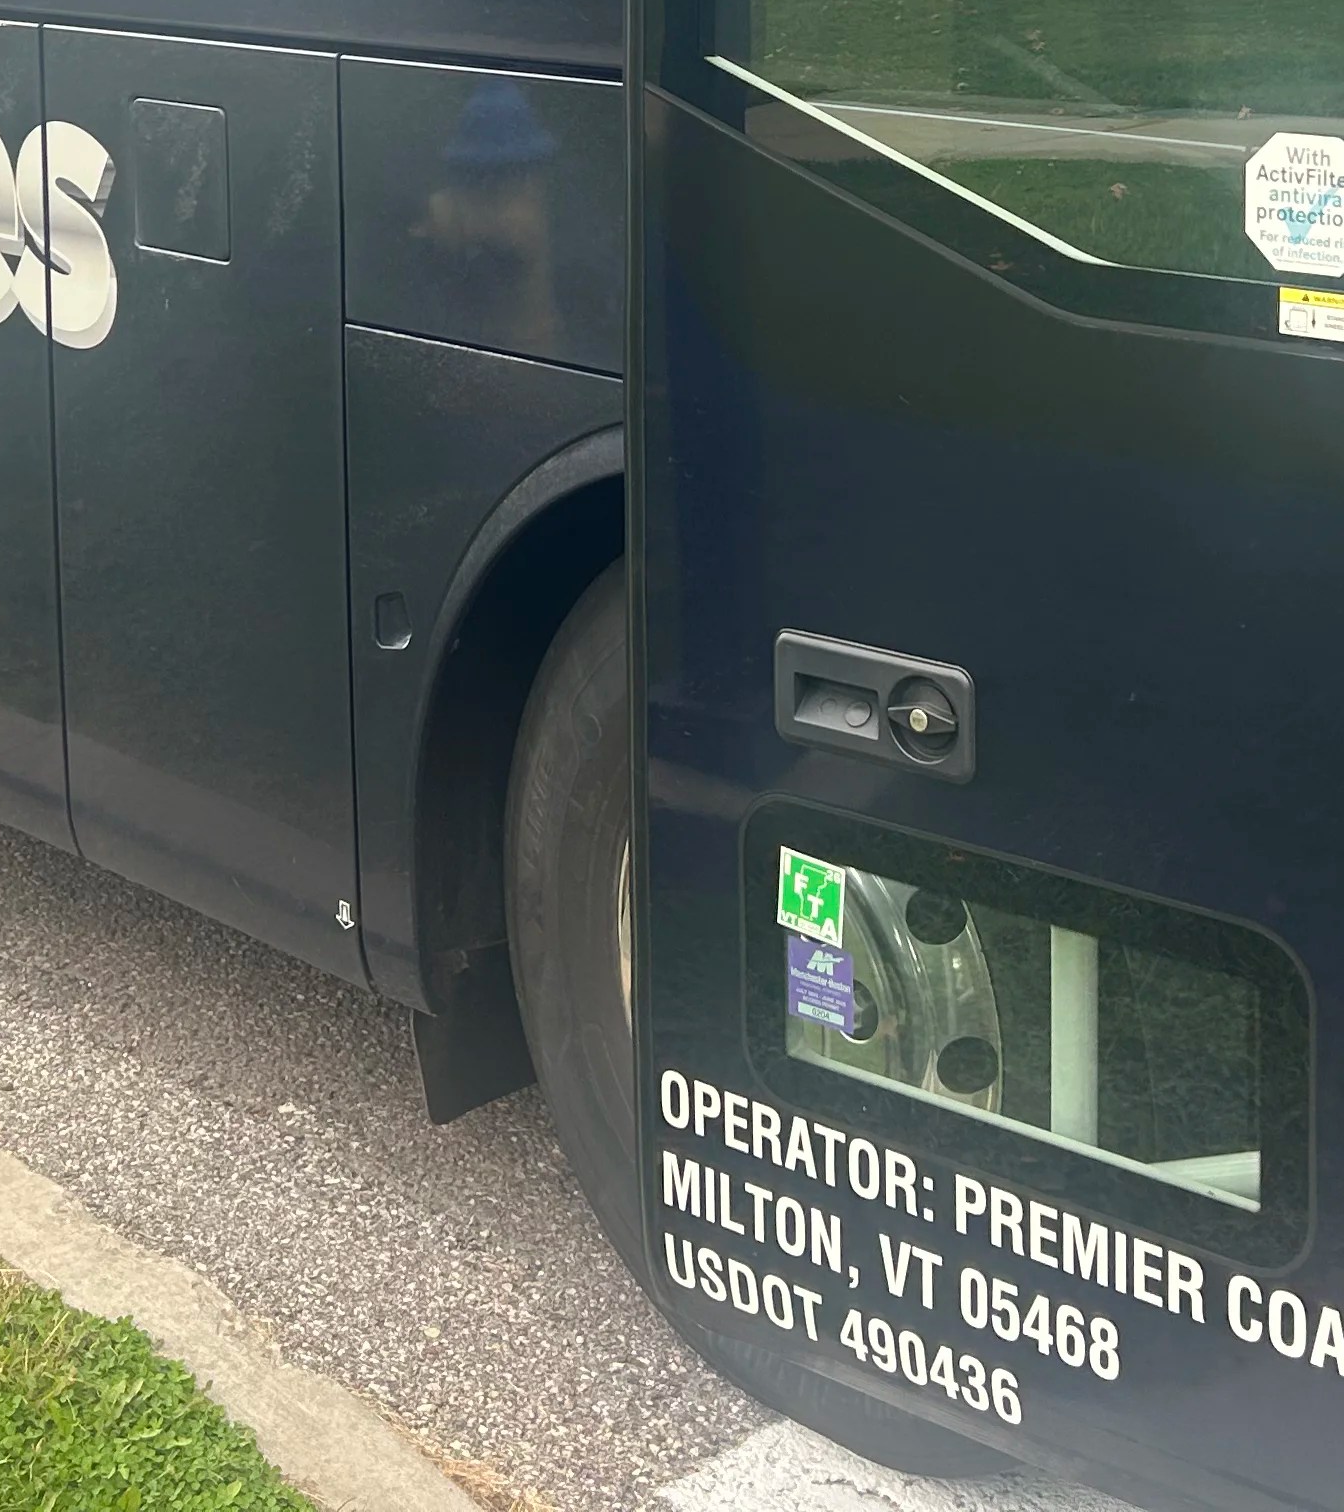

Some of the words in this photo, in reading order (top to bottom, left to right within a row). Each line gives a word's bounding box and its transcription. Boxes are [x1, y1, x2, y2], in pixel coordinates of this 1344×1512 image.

[1285, 146, 1331, 166] With
[1259, 229, 1278, 243] For
[1282, 233, 1331, 249] reduced
[1272, 246, 1284, 257] of
[1288, 246, 1344, 264] infection.
[659, 1069, 936, 1223] OPERATOR:
[955, 1172, 1206, 1324] PREMIER
[661, 1150, 859, 1287] MILTON,
[880, 1235, 944, 1294] VT
[960, 1266, 1120, 1382] 05468
[664, 1232, 824, 1344] USDOT
[839, 1308, 1024, 1426] 490436
